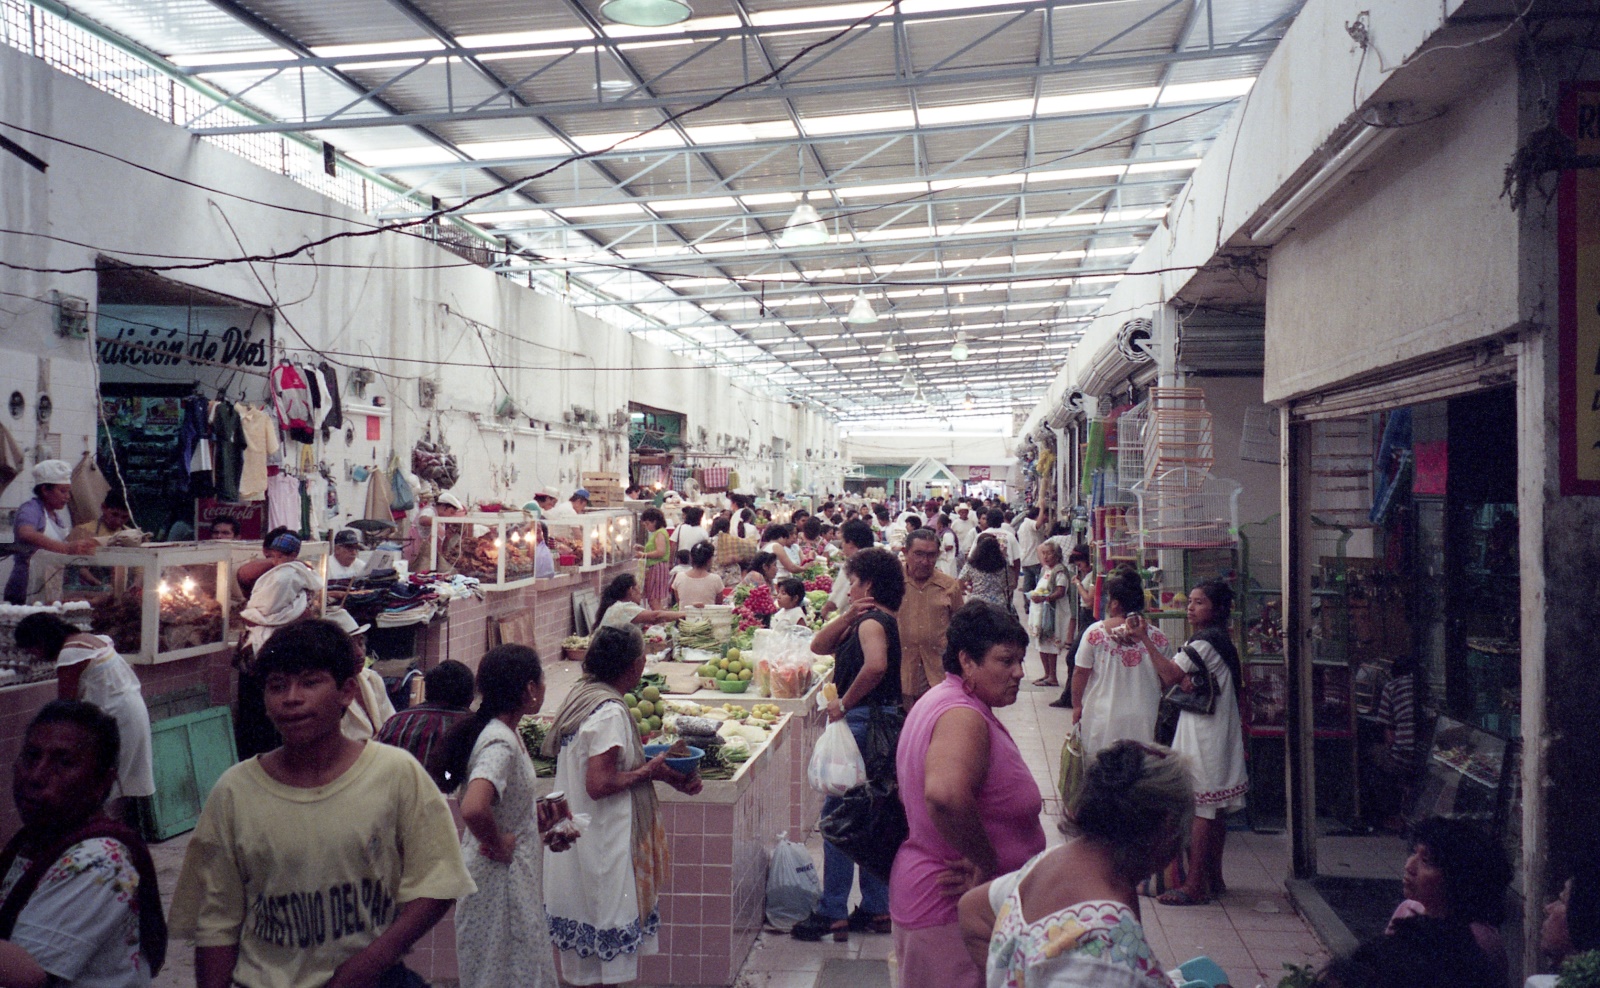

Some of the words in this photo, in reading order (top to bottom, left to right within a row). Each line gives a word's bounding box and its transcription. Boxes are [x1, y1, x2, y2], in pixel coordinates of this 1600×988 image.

[97, 328, 184, 366] dición
[188, 329, 217, 366] de
[221, 326, 268, 367] Dios
[329, 882, 365, 940] DEL
